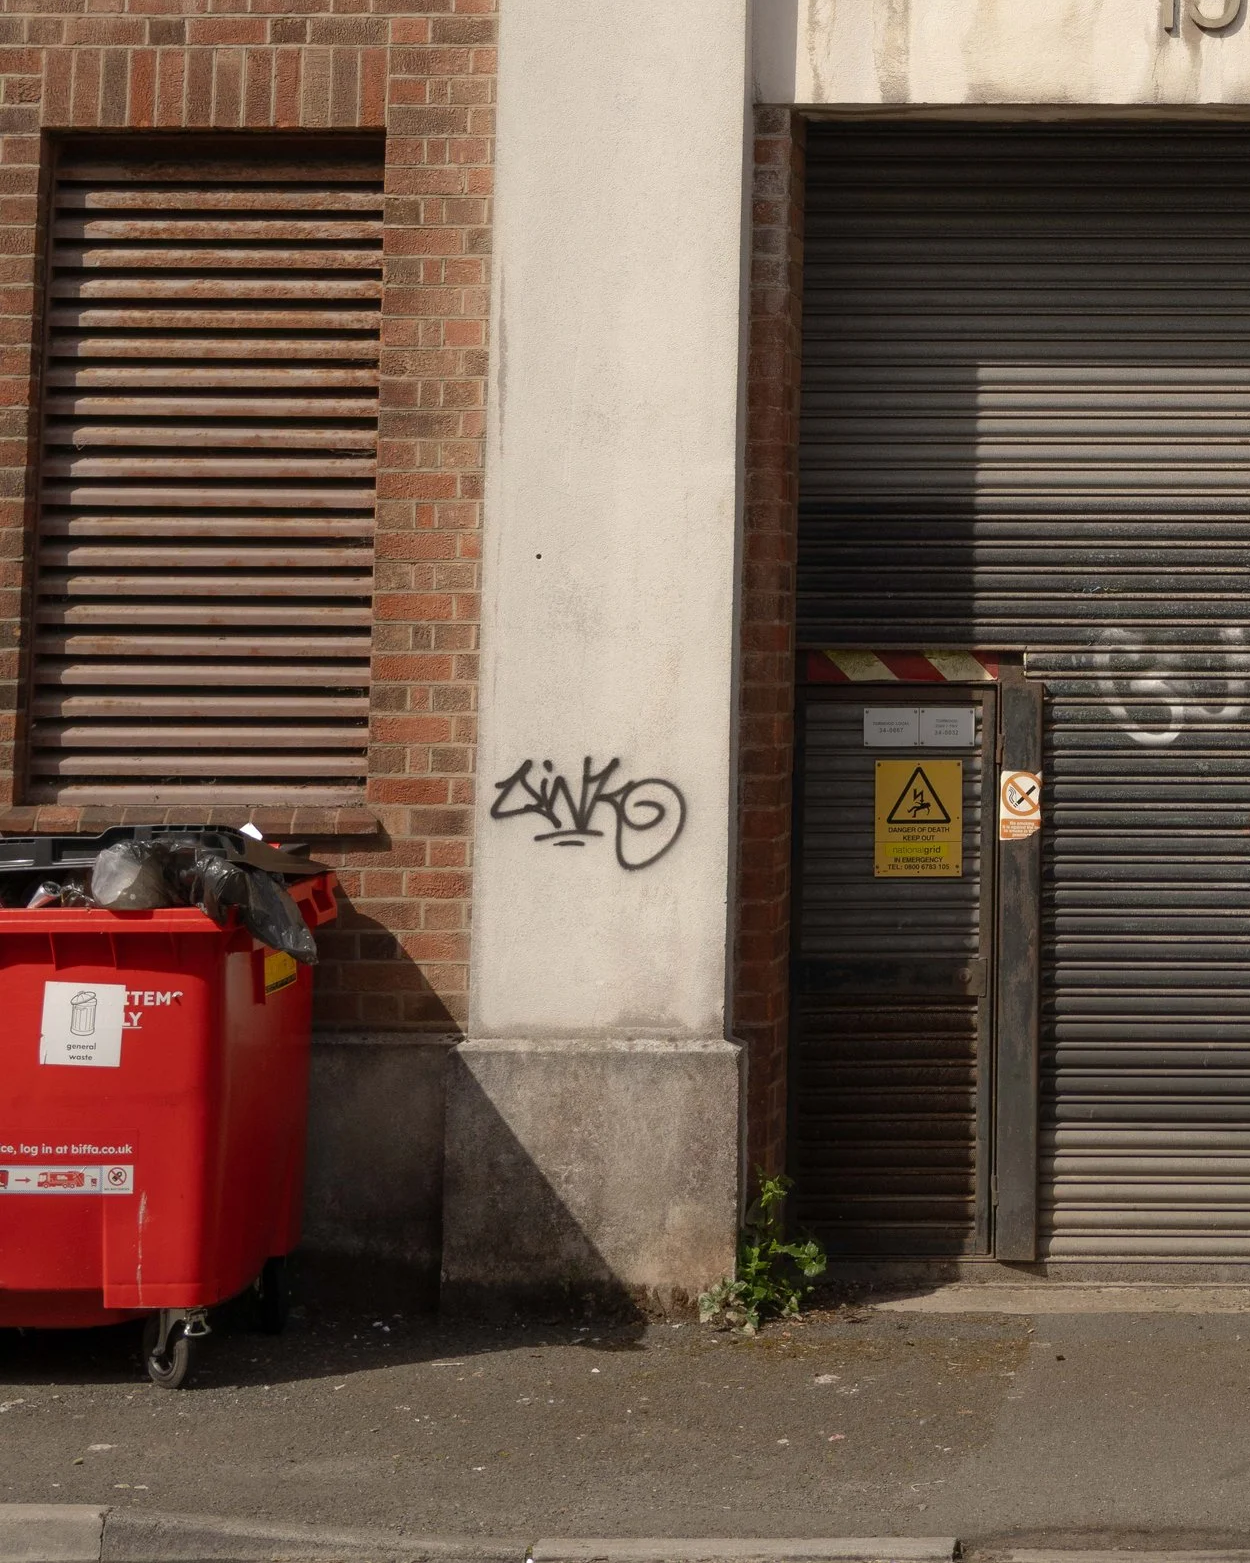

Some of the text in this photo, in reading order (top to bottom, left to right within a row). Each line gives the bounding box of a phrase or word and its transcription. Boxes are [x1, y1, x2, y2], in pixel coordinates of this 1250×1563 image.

[66, 1042, 97, 1051] general
[20, 1143, 39, 1156] log
[41, 1143, 53, 1154] in
[55, 1145, 69, 1154] at
[71, 1144, 133, 1154] biffa.co.uk
